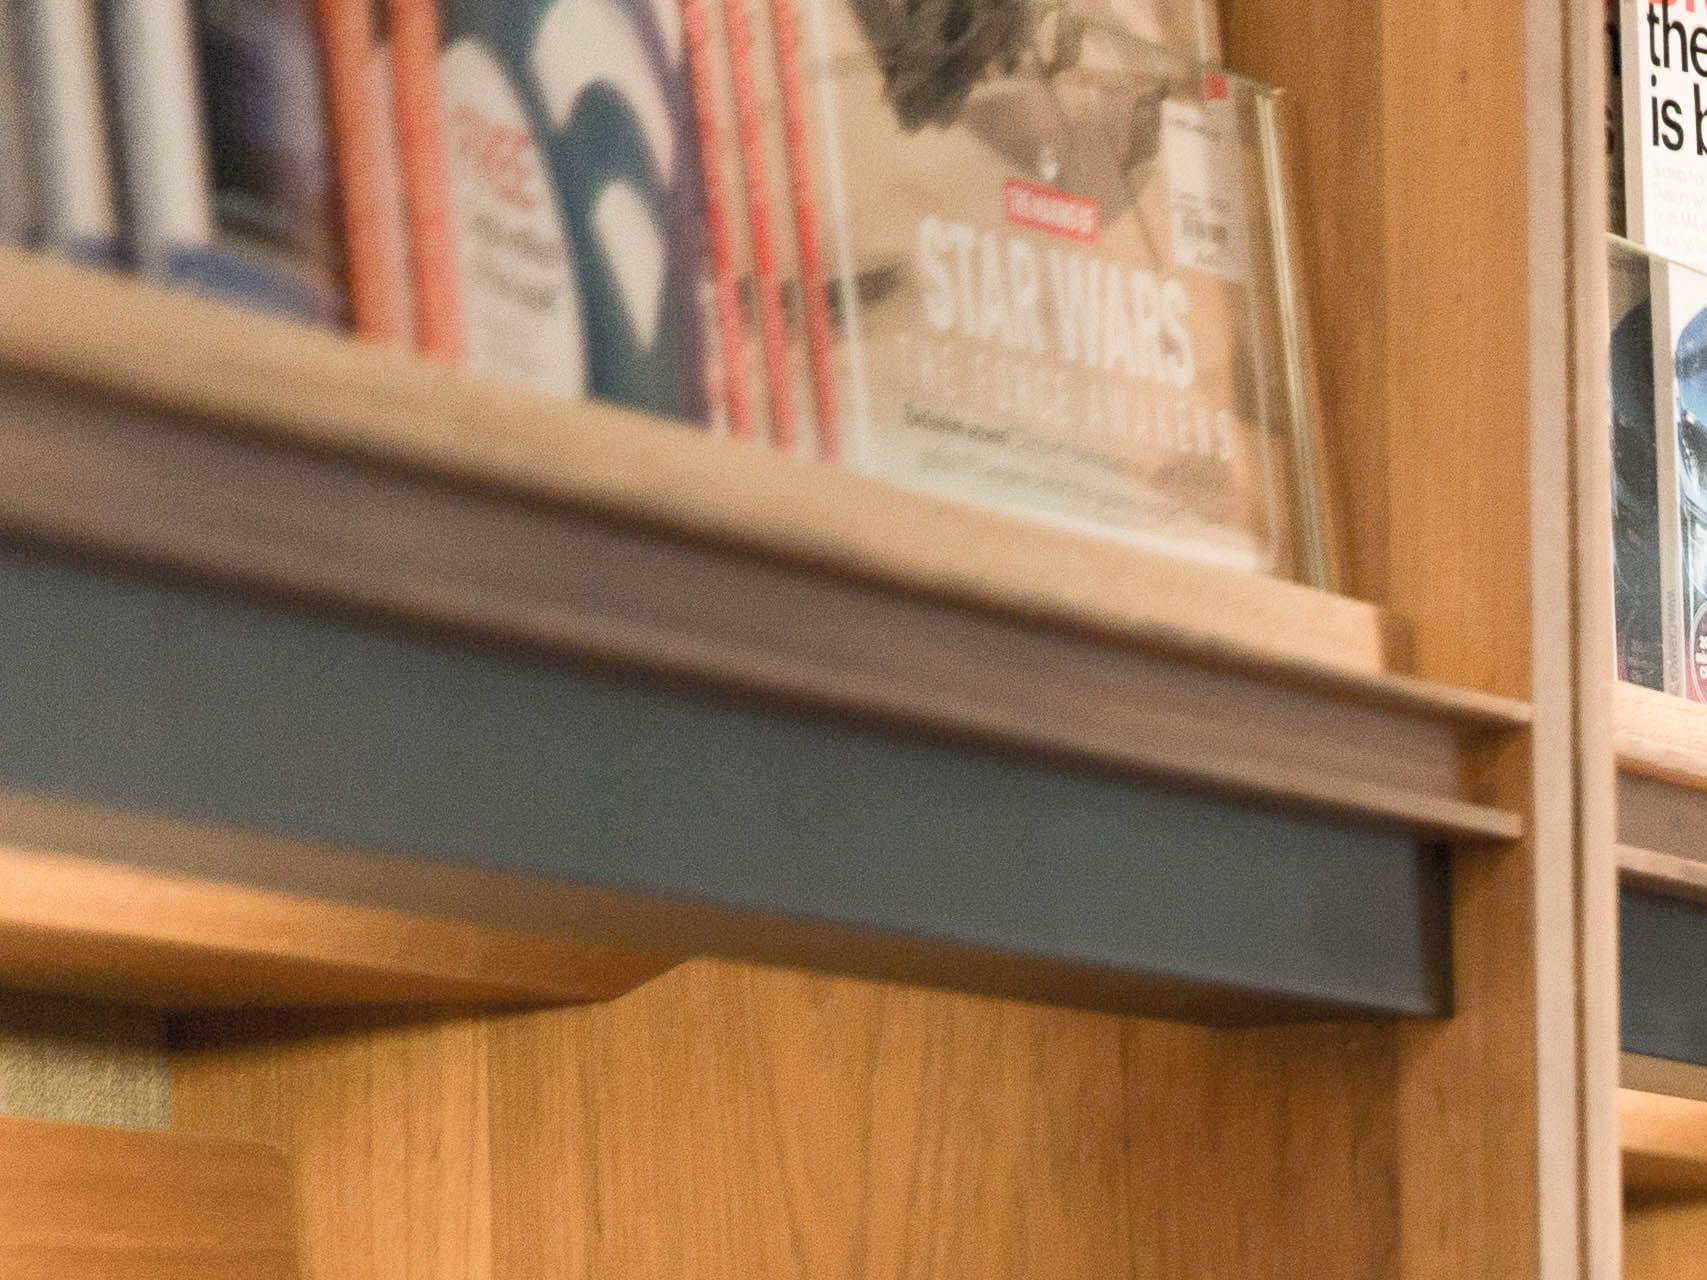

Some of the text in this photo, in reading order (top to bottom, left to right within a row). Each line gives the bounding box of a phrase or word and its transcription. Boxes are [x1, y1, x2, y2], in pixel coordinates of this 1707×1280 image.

[1650, 74, 1684, 151] is
[916, 214, 1045, 352] STAR
[1050, 244, 1193, 389] WARS
